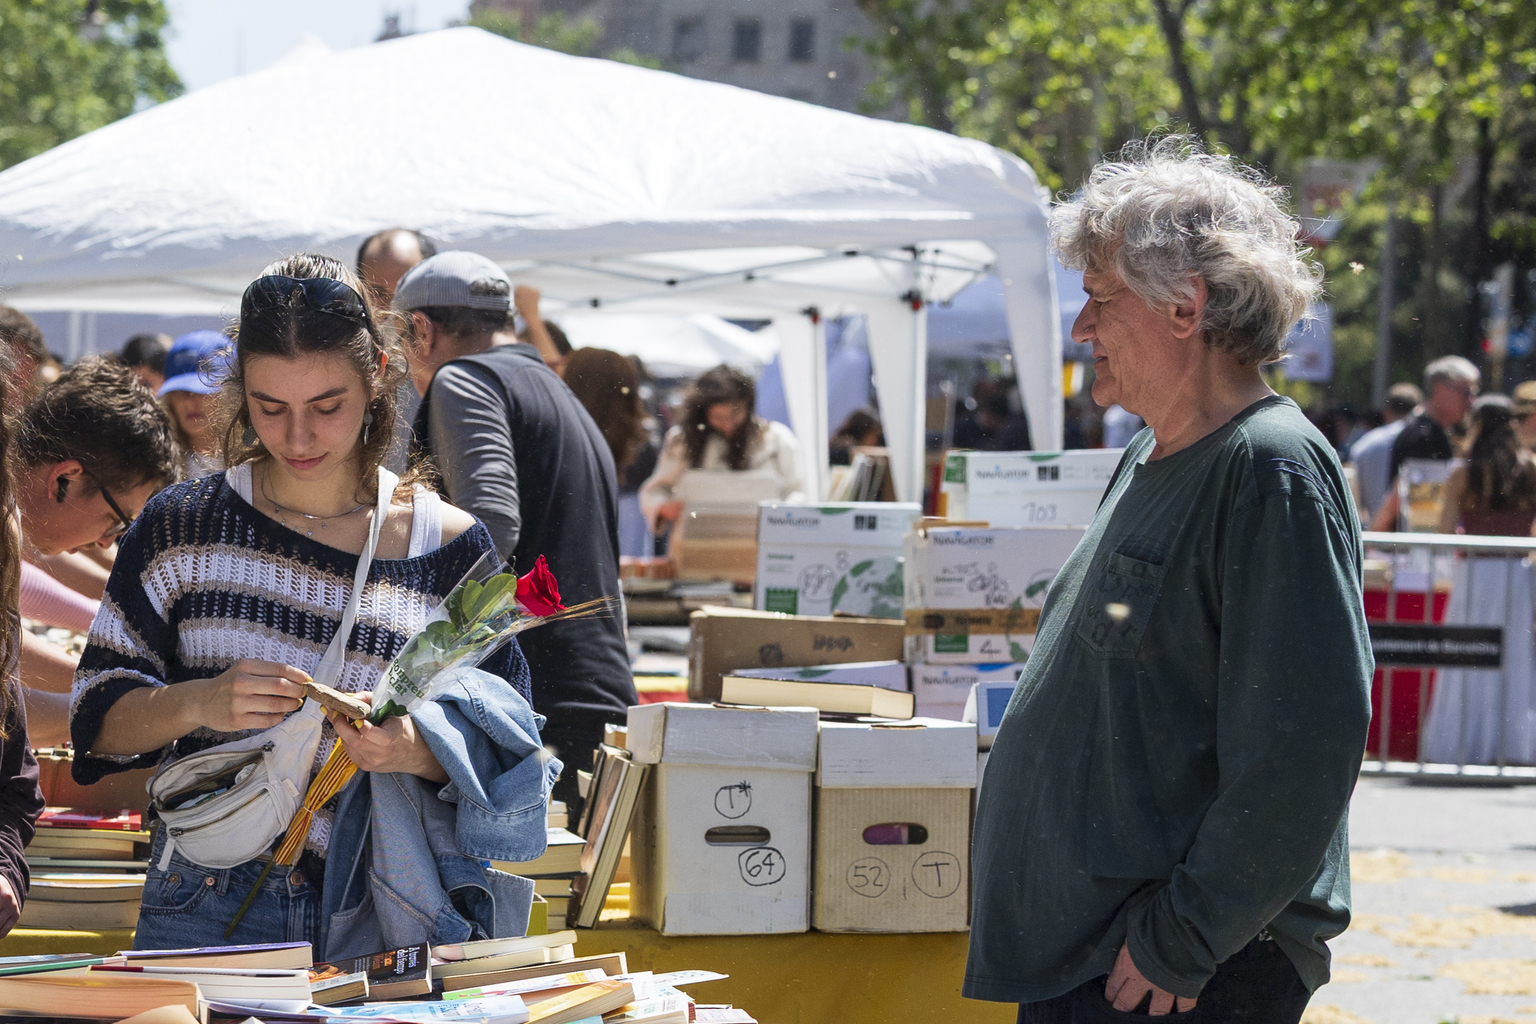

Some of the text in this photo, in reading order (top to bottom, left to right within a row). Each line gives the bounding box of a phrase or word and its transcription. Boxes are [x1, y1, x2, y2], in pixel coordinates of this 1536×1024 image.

[745, 851, 775, 878] 64
[853, 865, 884, 888] 52
[922, 861, 951, 888] T
